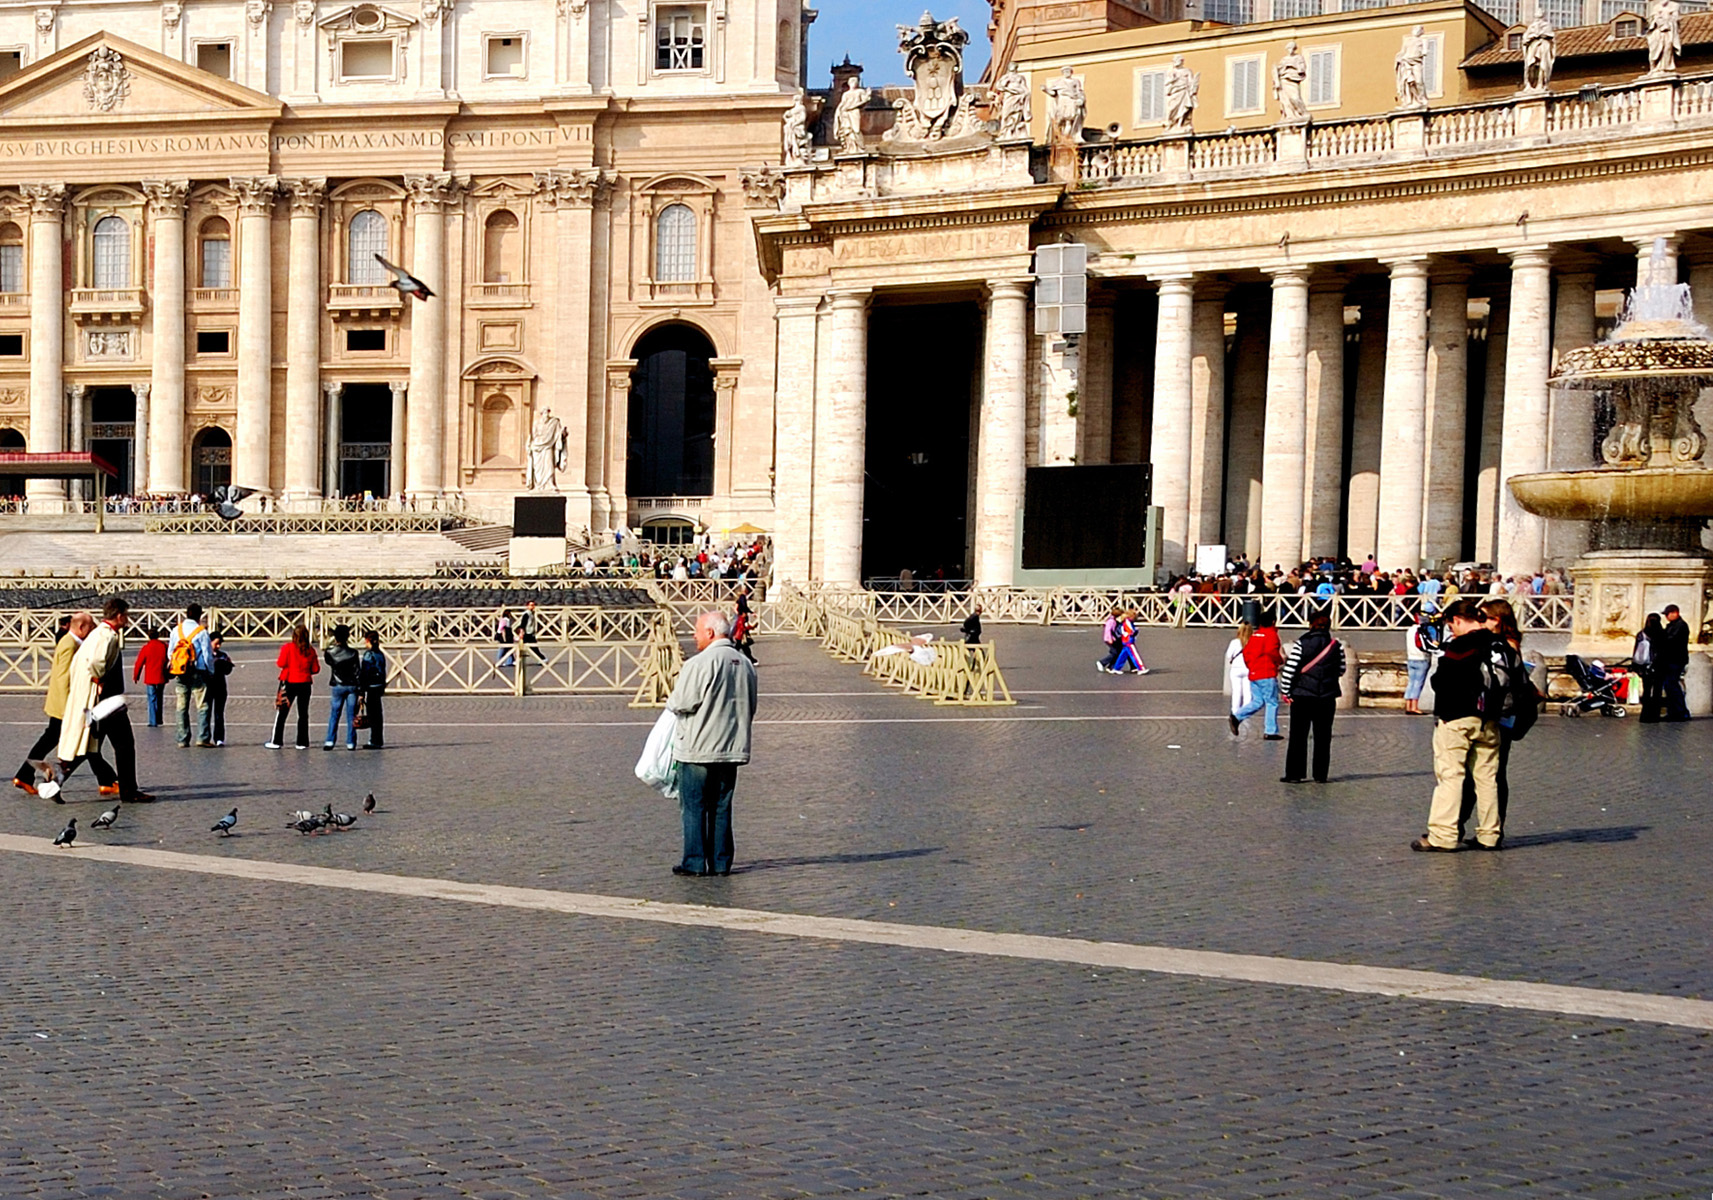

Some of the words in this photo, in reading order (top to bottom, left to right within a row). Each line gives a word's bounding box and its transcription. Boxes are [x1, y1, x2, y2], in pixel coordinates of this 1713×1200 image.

[35, 137, 159, 156] BVRGHESIVS
[164, 134, 269, 153] ROMANVS
[275, 133, 329, 151] PONT
[329, 132, 376, 149] MAX
[500, 130, 556, 146] PONT
[561, 126, 590, 142] VII
